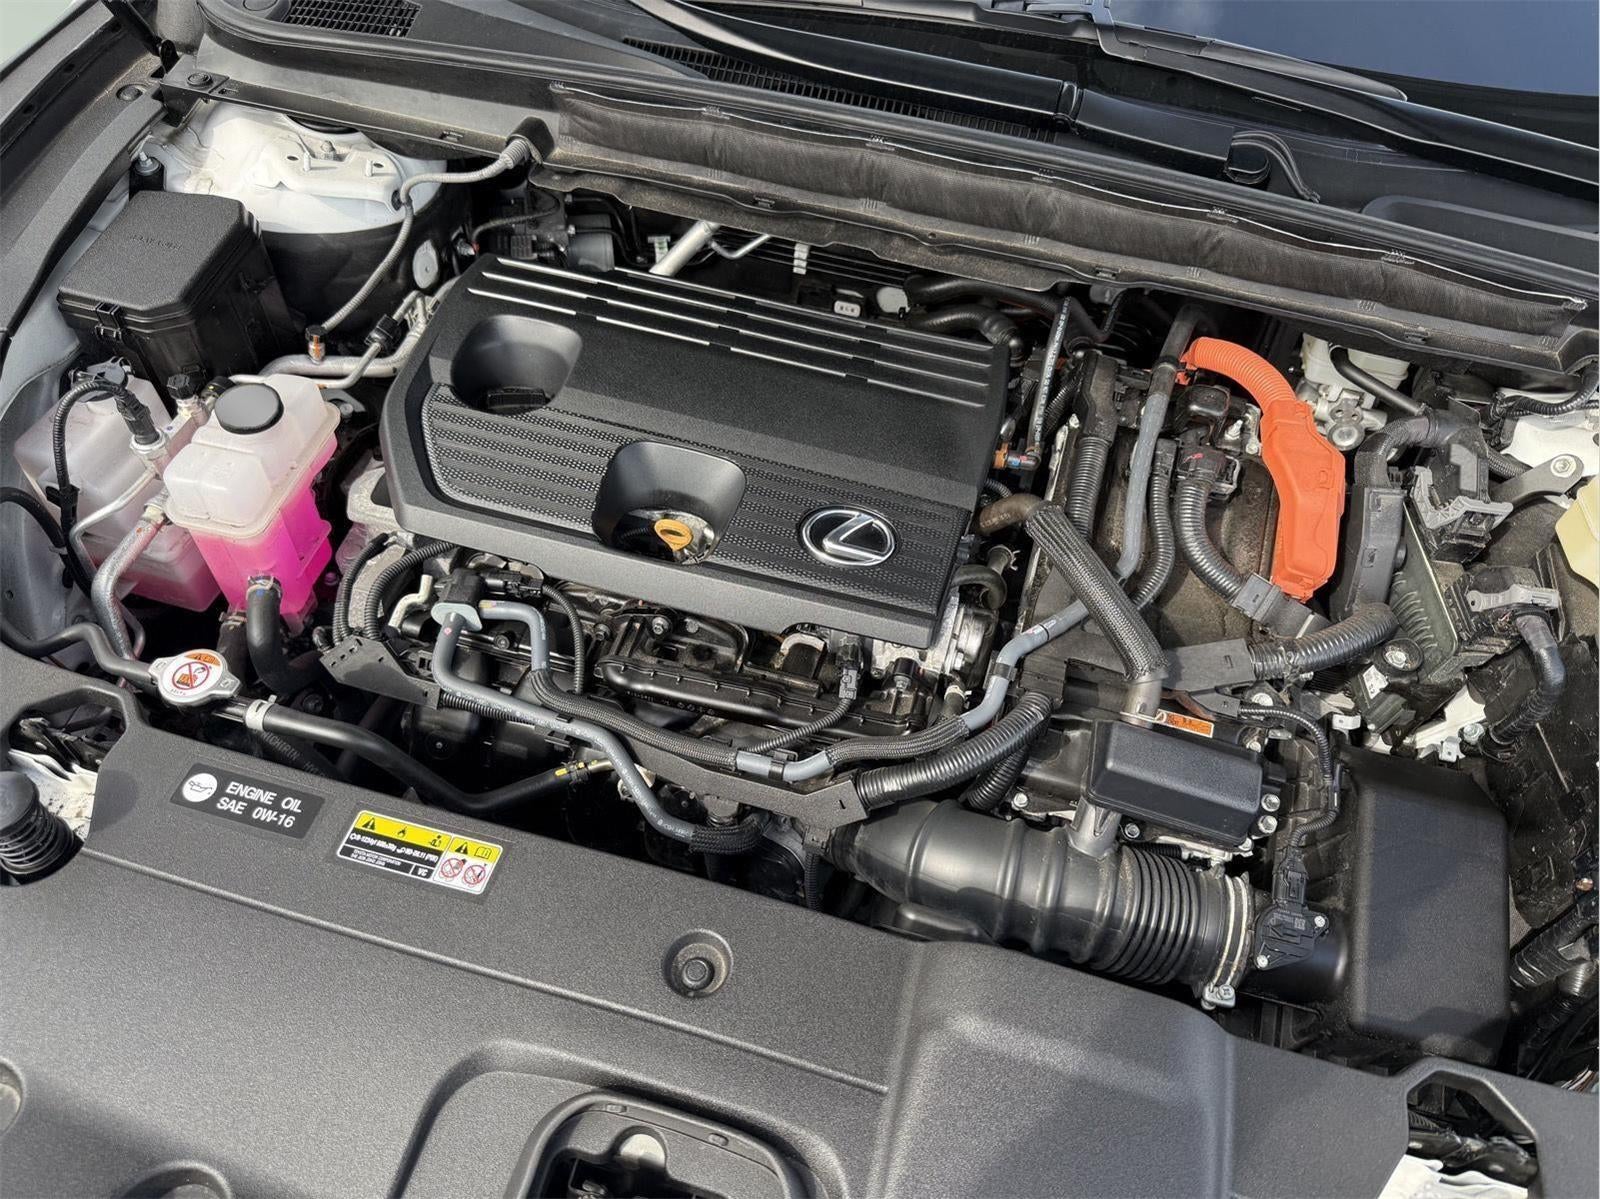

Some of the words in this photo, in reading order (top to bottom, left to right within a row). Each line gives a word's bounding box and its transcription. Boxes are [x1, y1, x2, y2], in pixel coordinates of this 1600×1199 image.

[216, 797, 248, 815] SAE
[252, 806, 296, 828] 0W-16
[225, 781, 277, 805] ENGINE
[281, 797, 302, 813] OIL
